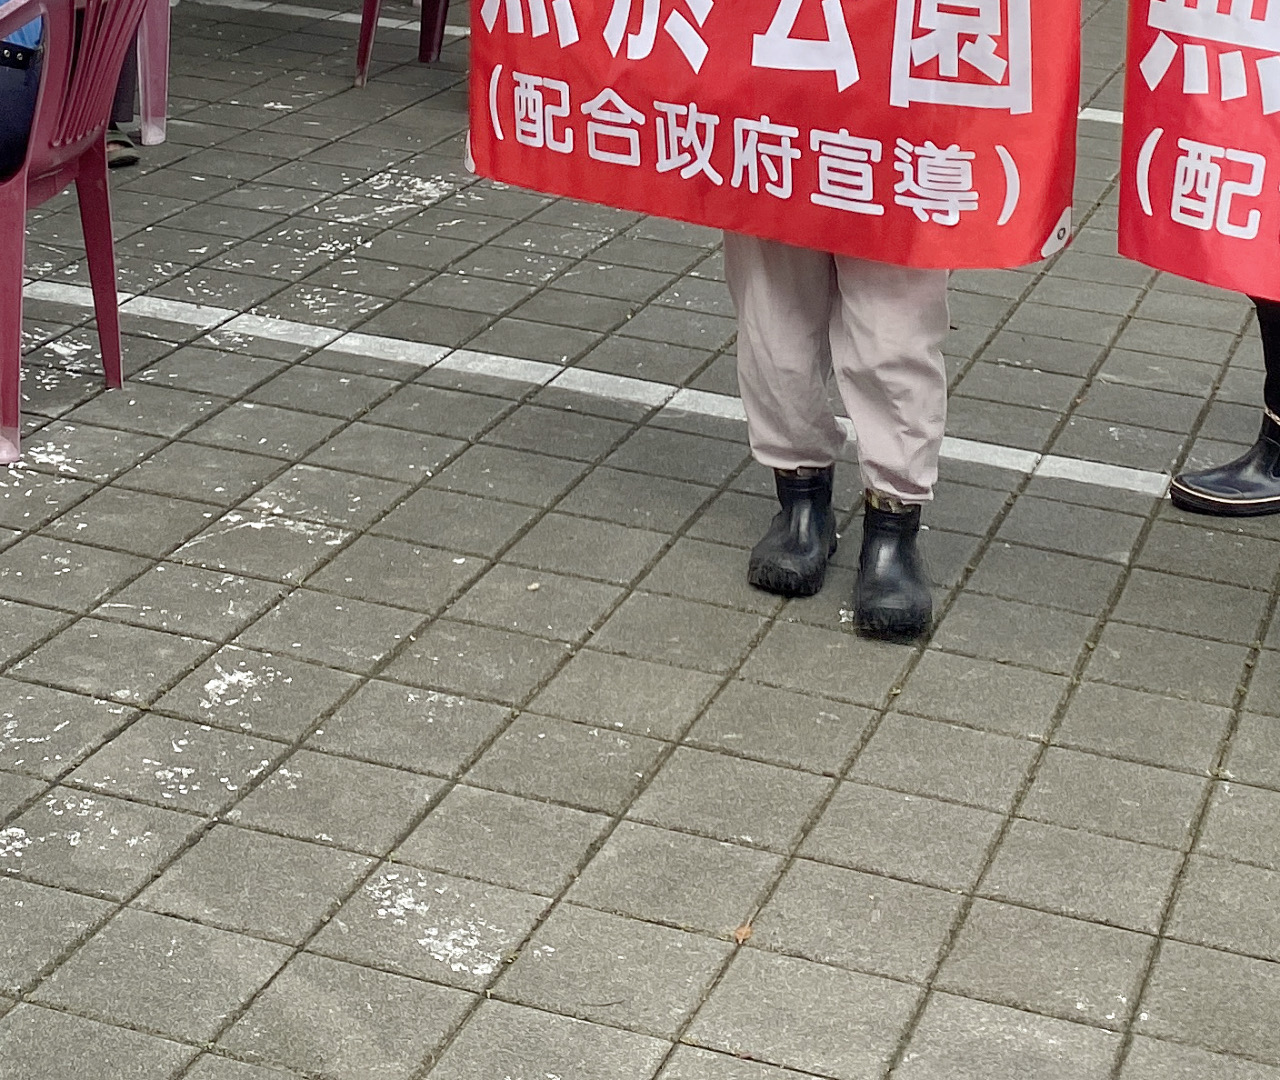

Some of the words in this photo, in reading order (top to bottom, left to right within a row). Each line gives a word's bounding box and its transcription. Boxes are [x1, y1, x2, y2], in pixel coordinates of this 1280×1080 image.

[489, 63, 1021, 226] (配合政府宣導)
